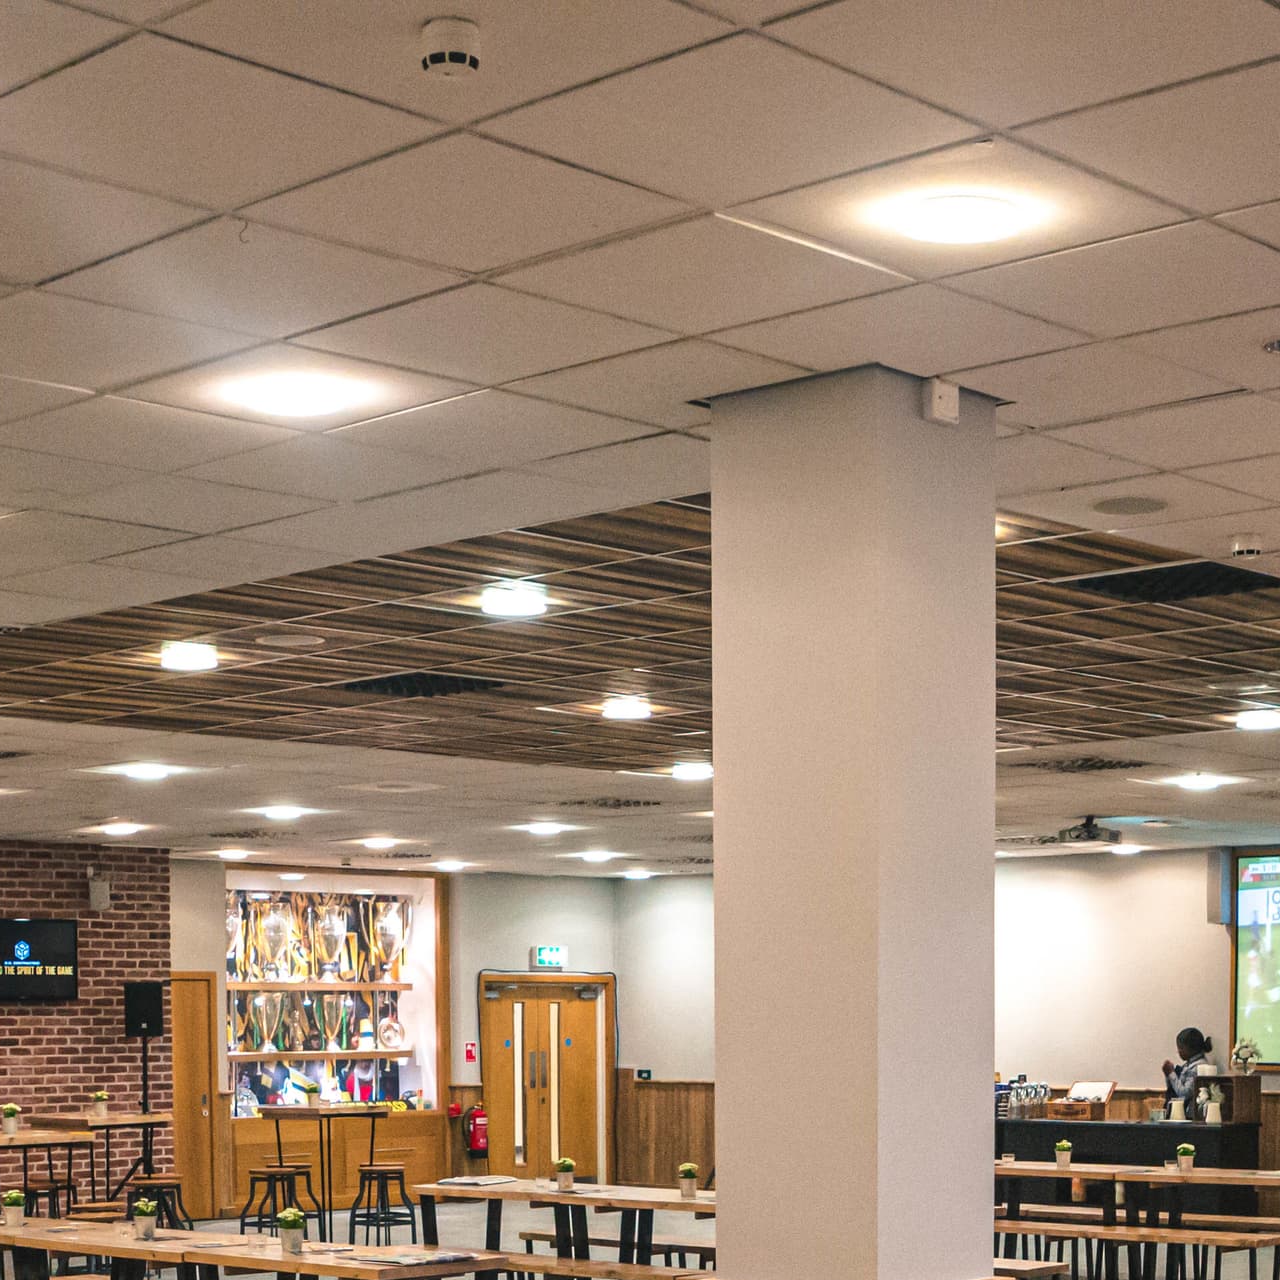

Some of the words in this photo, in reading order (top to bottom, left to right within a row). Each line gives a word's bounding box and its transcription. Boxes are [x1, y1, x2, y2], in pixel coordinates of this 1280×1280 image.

[4, 965, 15, 975] THE
[36, 965, 43, 975] OF
[45, 965, 56, 975] THE
